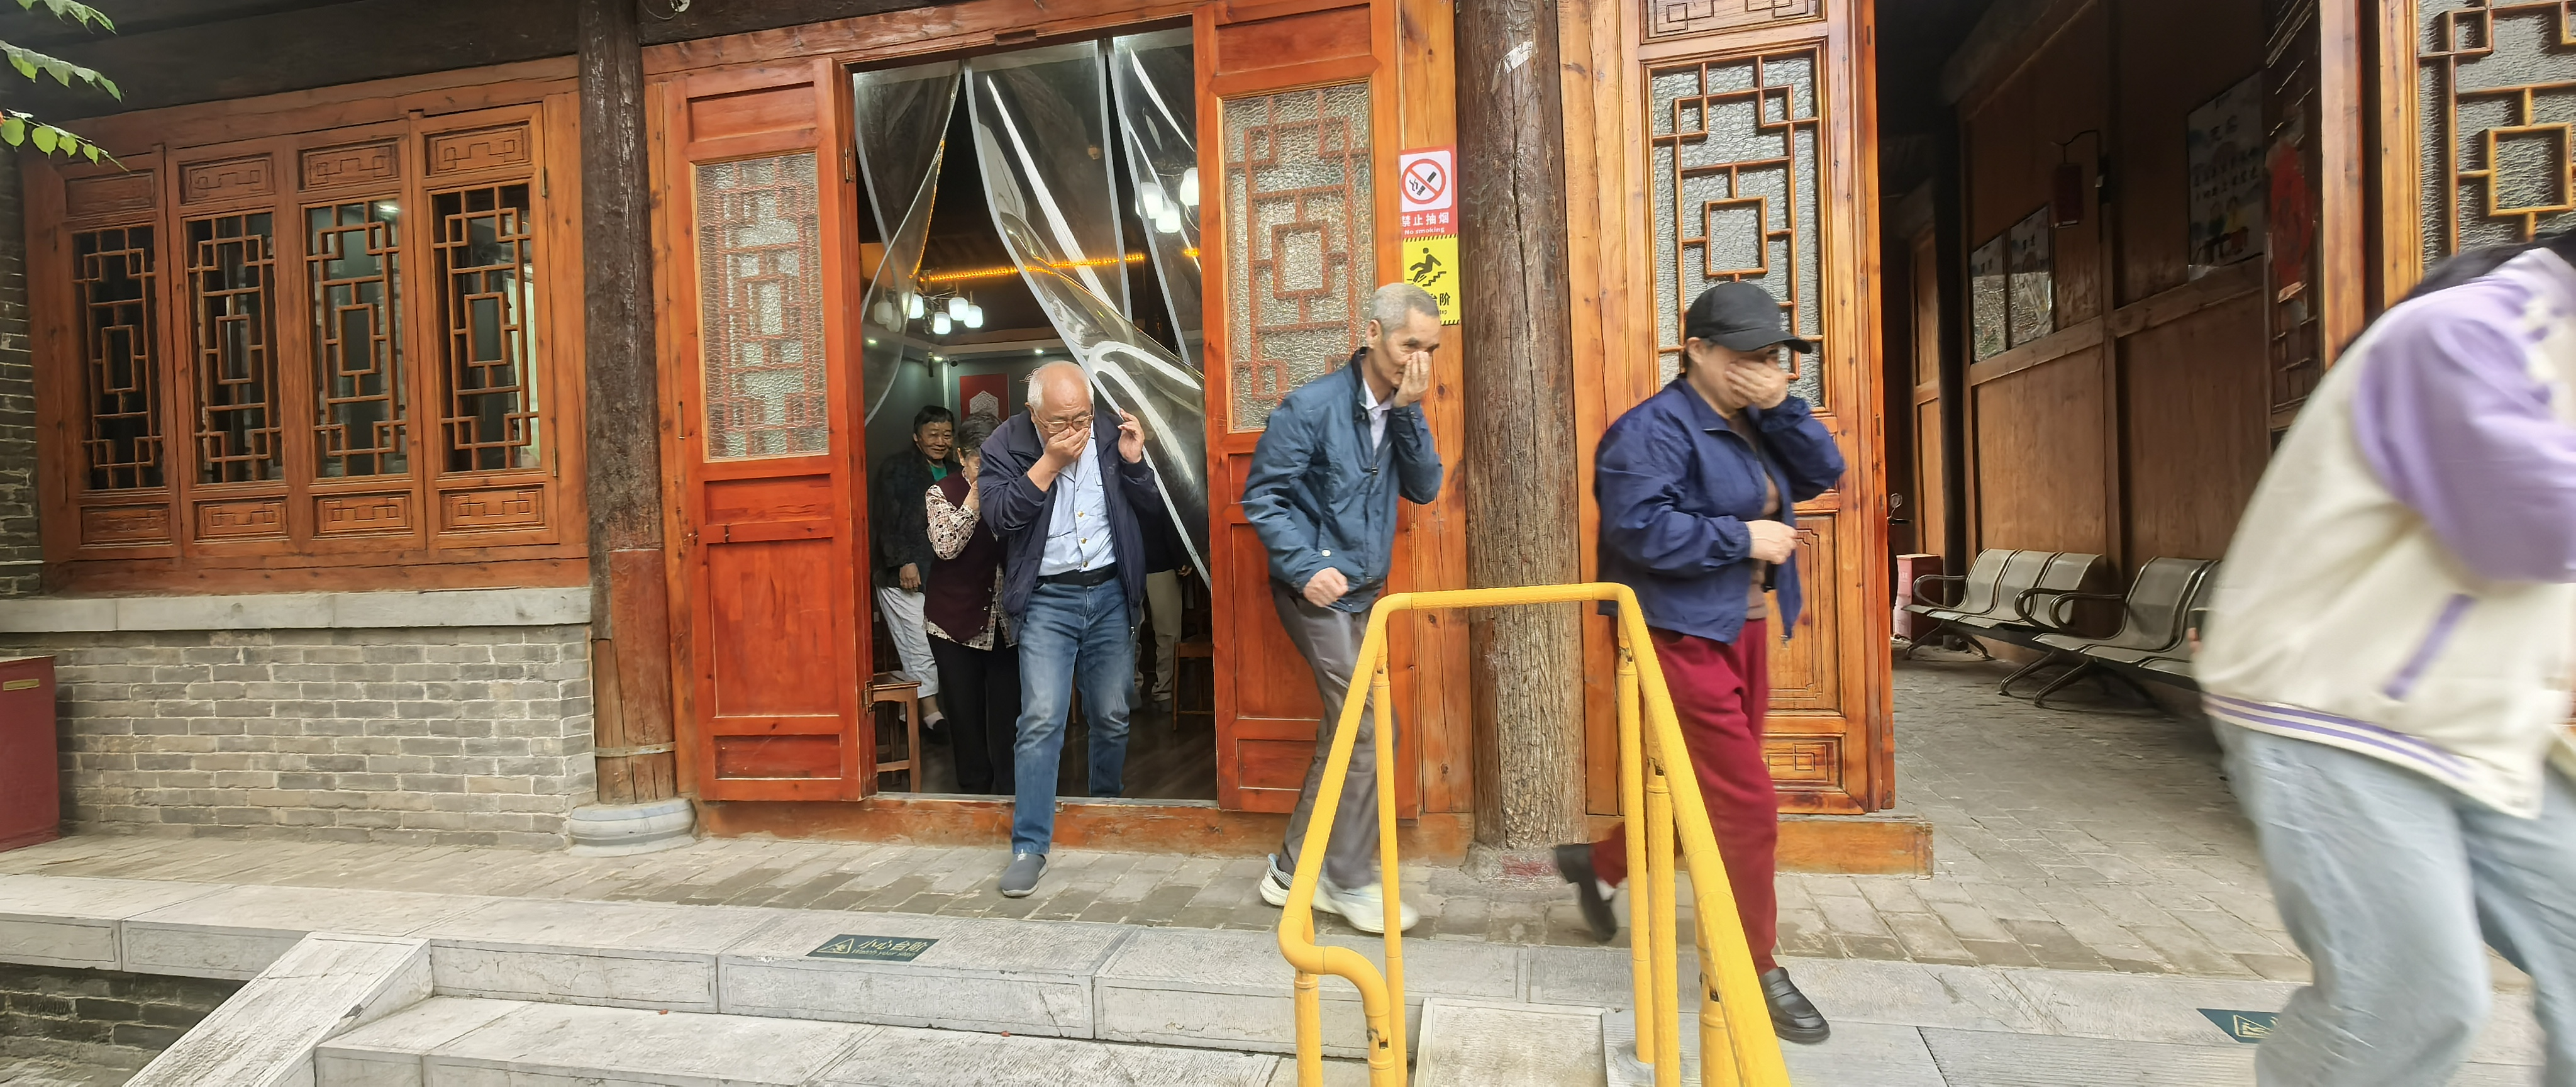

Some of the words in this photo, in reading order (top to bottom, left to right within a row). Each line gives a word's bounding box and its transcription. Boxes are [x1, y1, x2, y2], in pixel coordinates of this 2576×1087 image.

[1402, 212, 1449, 227] 禁止抽烟
[858, 939, 928, 951] 小心台阶
